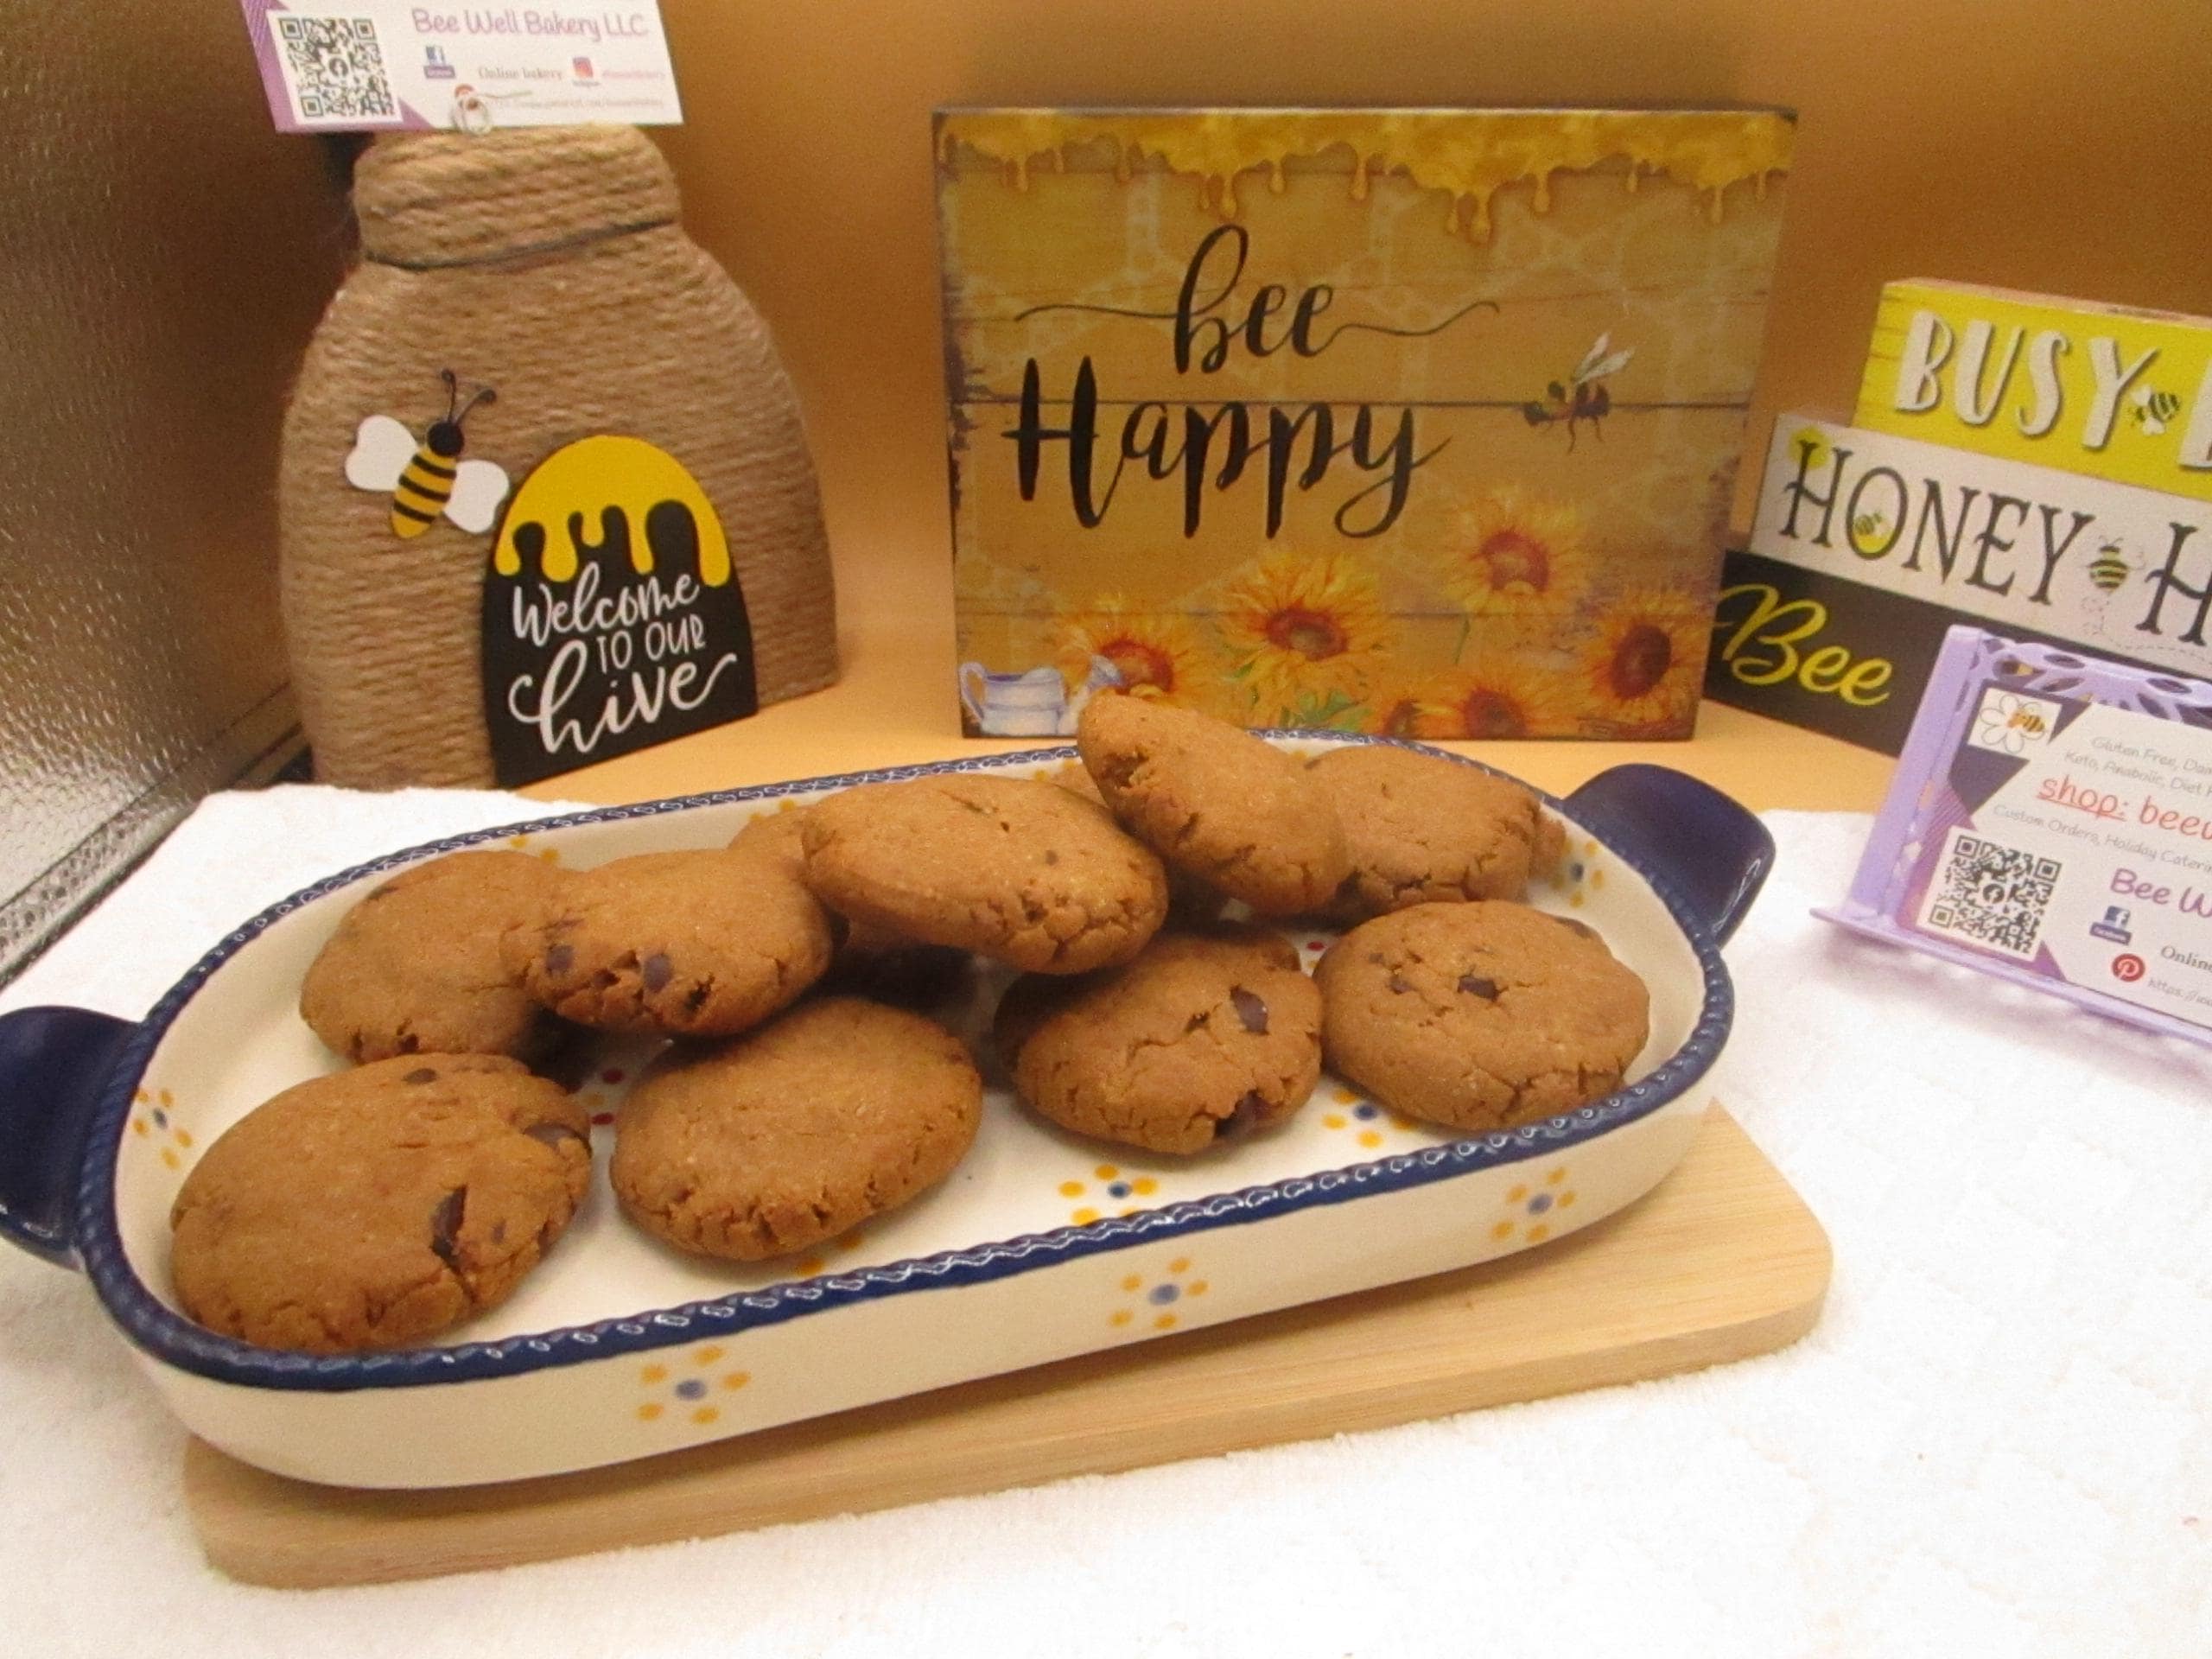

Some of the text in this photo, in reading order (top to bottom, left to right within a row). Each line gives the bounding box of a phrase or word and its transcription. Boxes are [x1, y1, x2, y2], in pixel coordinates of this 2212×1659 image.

[411, 8, 651, 42] Bee Well Bakery LLC
[1895, 311, 2159, 451] BUSY
[1002, 355, 1452, 538] Happy
[1779, 440, 2097, 606] HONEY
[512, 562, 700, 646] Welcome
[596, 614, 705, 674] TO OUR
[1717, 584, 1892, 706] Bee
[508, 639, 737, 753] hive
[2091, 736, 2139, 757] Gluten
[1993, 804, 2044, 827] Custom
[2104, 834, 2158, 860] Holiday
[2037, 775, 2129, 822] shop:
[2110, 868, 2171, 905] Bee
